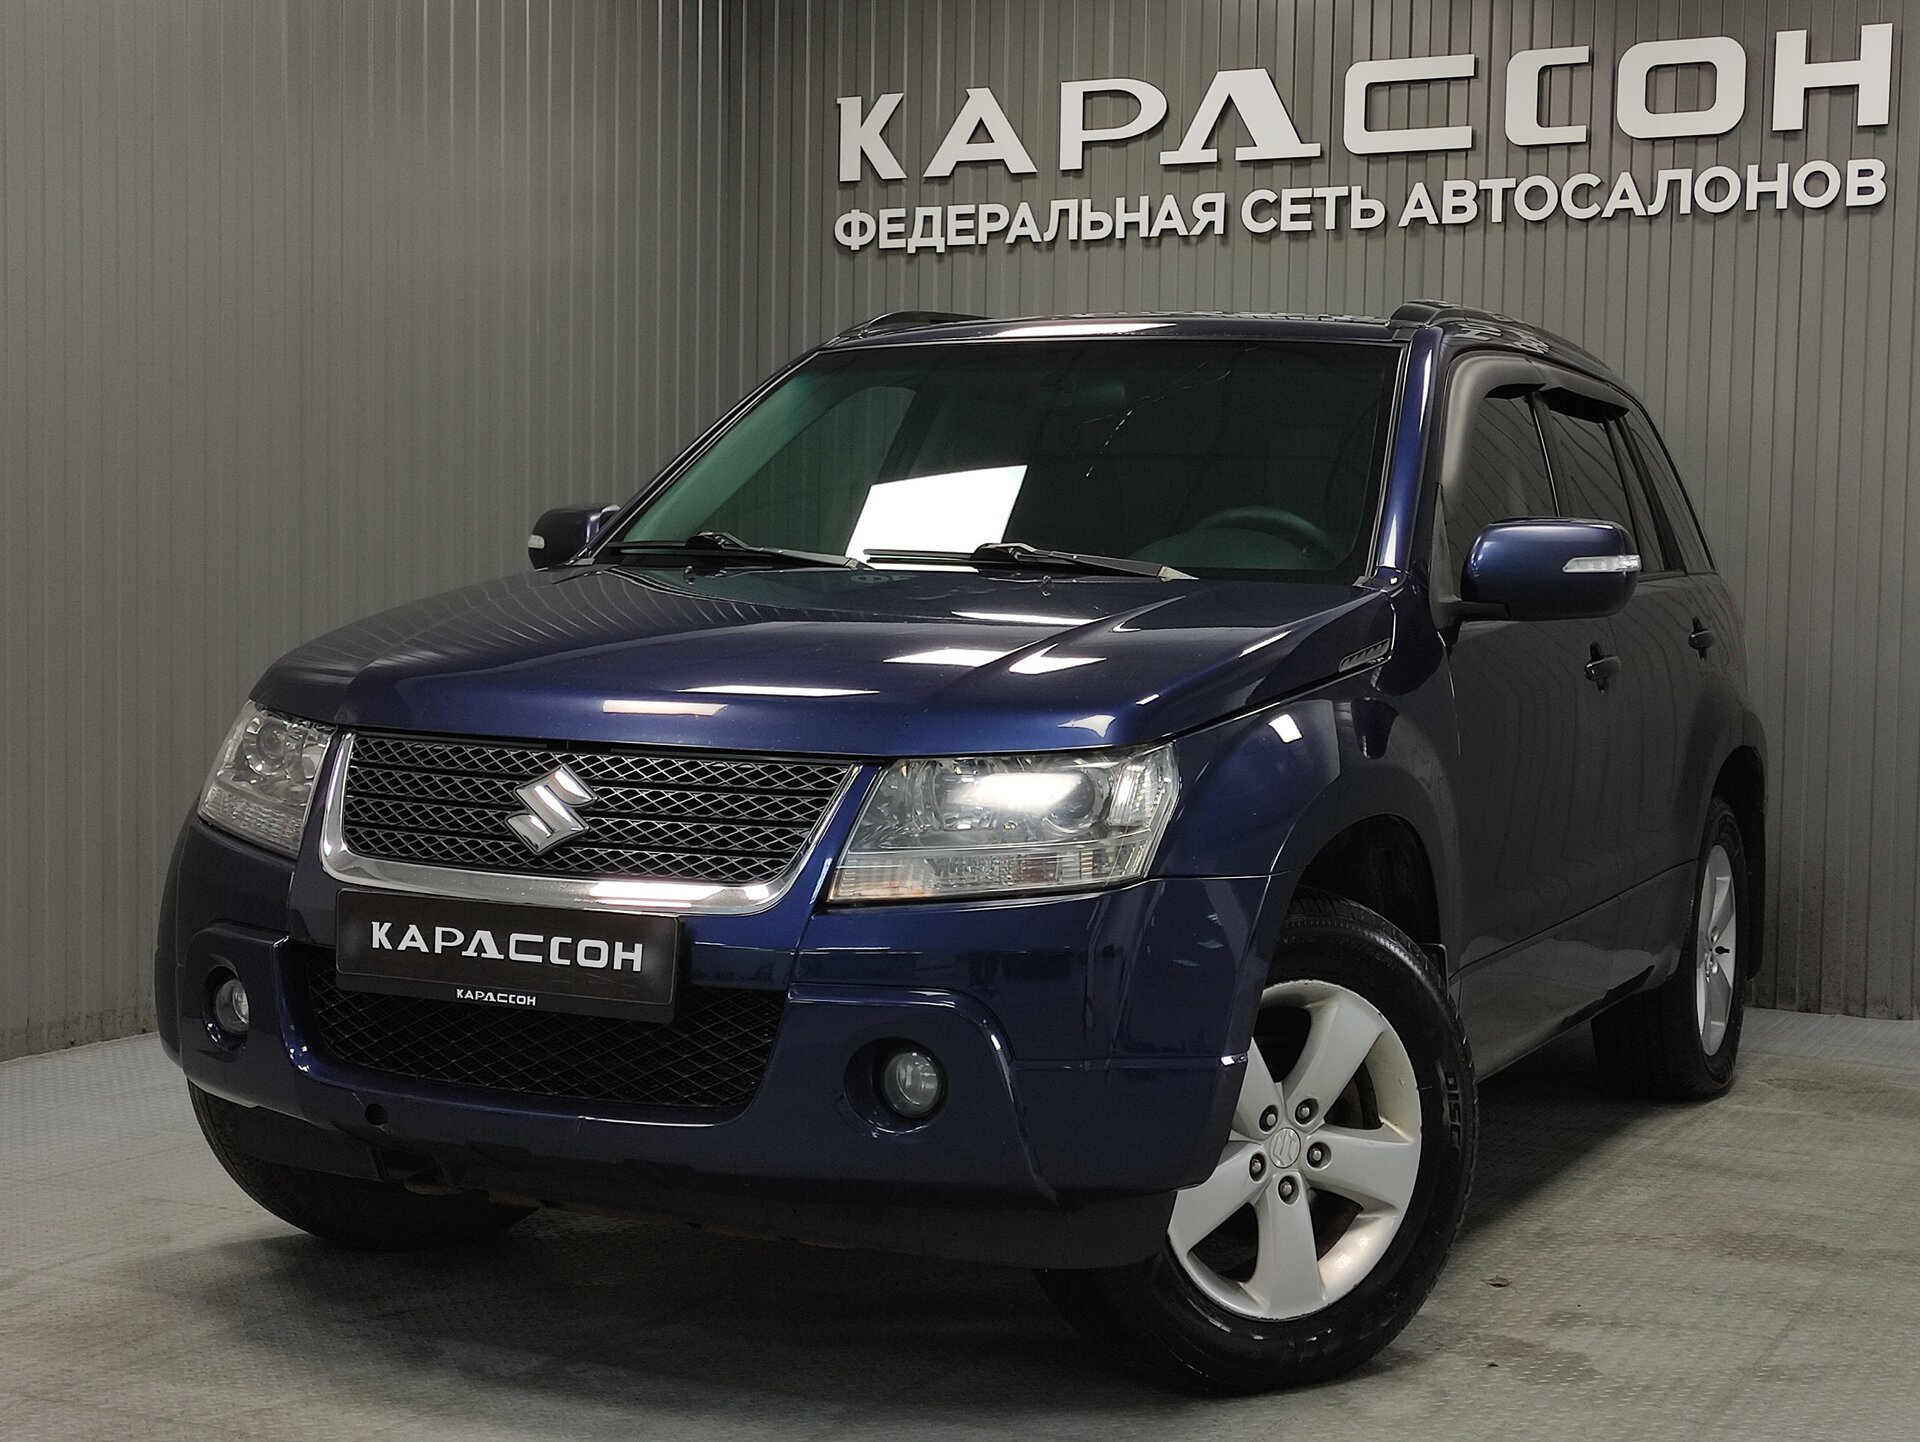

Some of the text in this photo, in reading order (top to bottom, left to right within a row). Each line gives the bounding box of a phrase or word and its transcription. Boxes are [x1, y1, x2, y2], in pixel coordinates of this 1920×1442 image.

[834, 158, 1888, 254] ФЕДЕРАЛЬНАЯ СЕТЬ АВТОСАЛОНОВ
